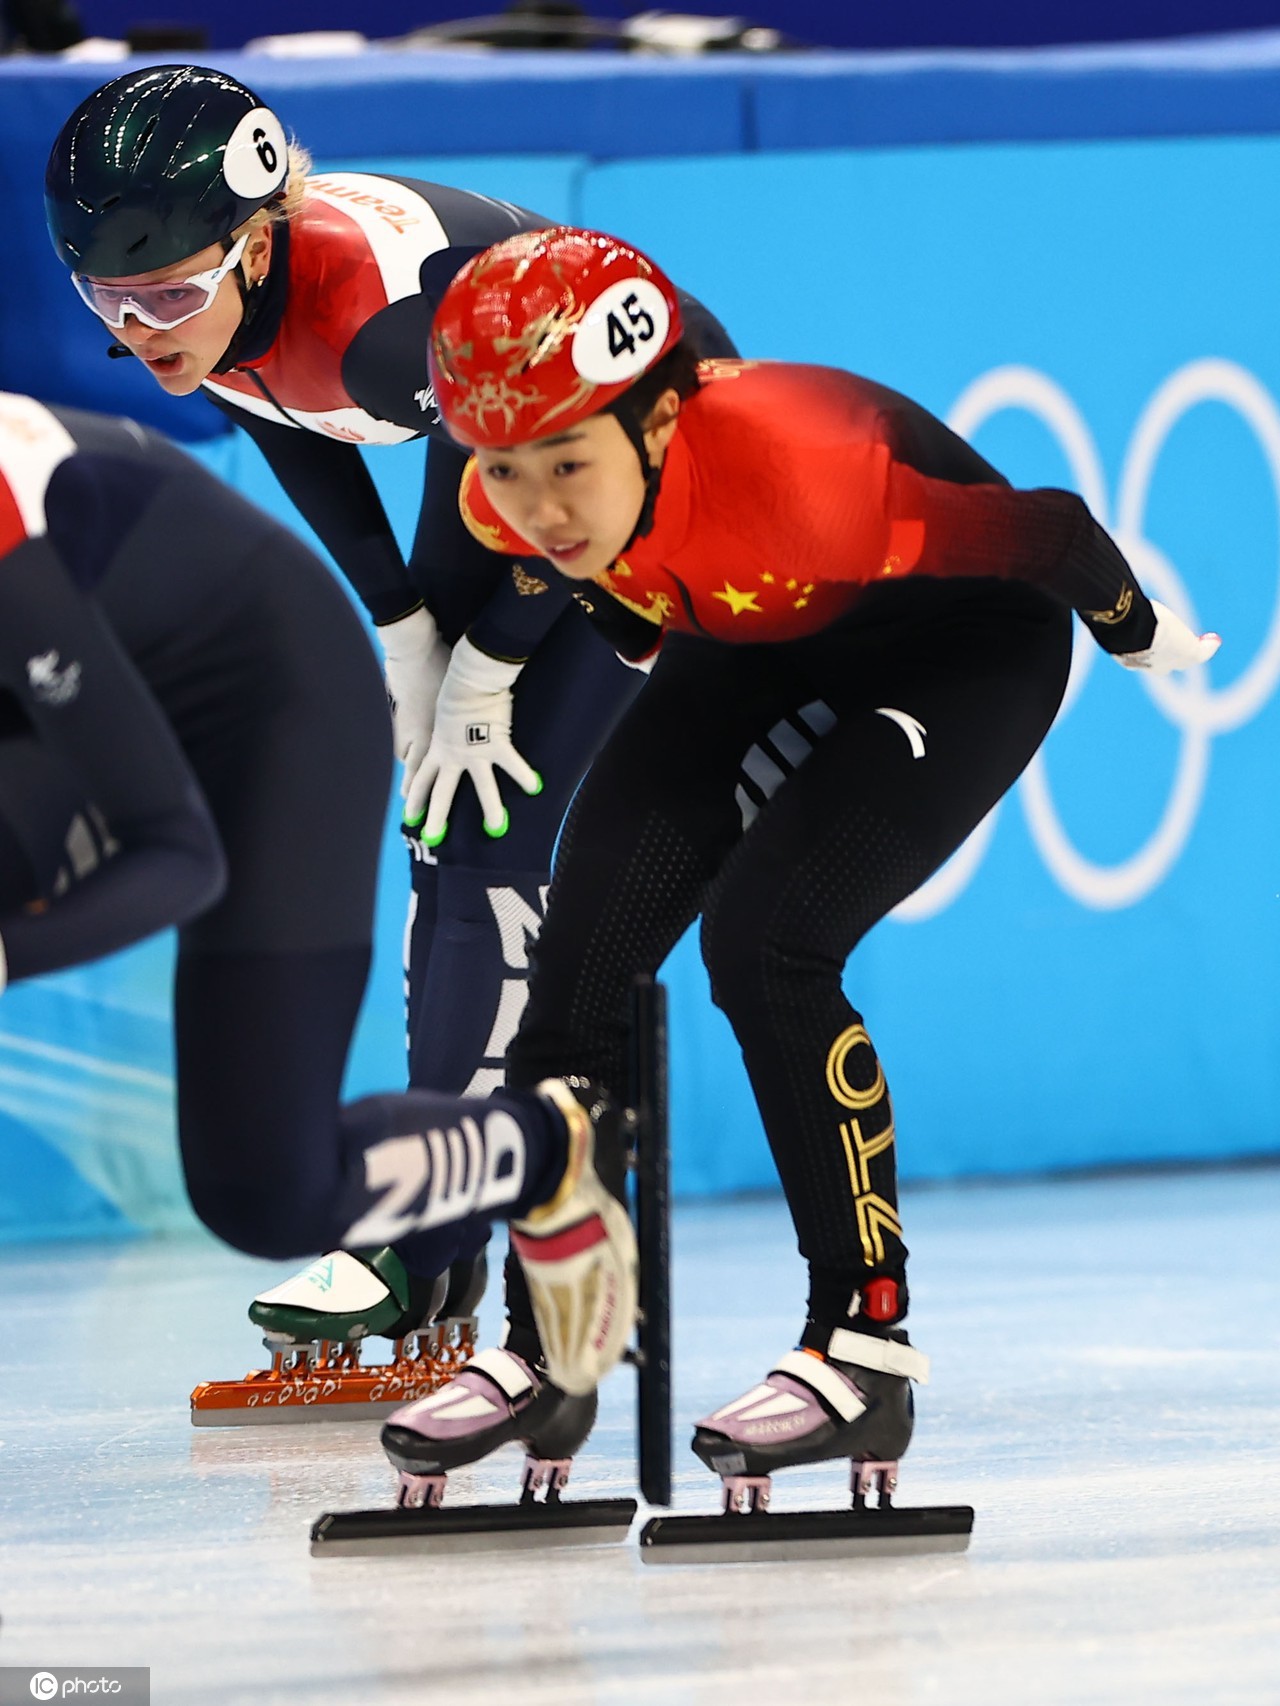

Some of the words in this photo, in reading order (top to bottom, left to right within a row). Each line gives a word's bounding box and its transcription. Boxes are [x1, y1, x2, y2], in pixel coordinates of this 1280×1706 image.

[252, 127, 278, 174] 6
[303, 180, 420, 235] Team
[606, 292, 655, 358] 45
